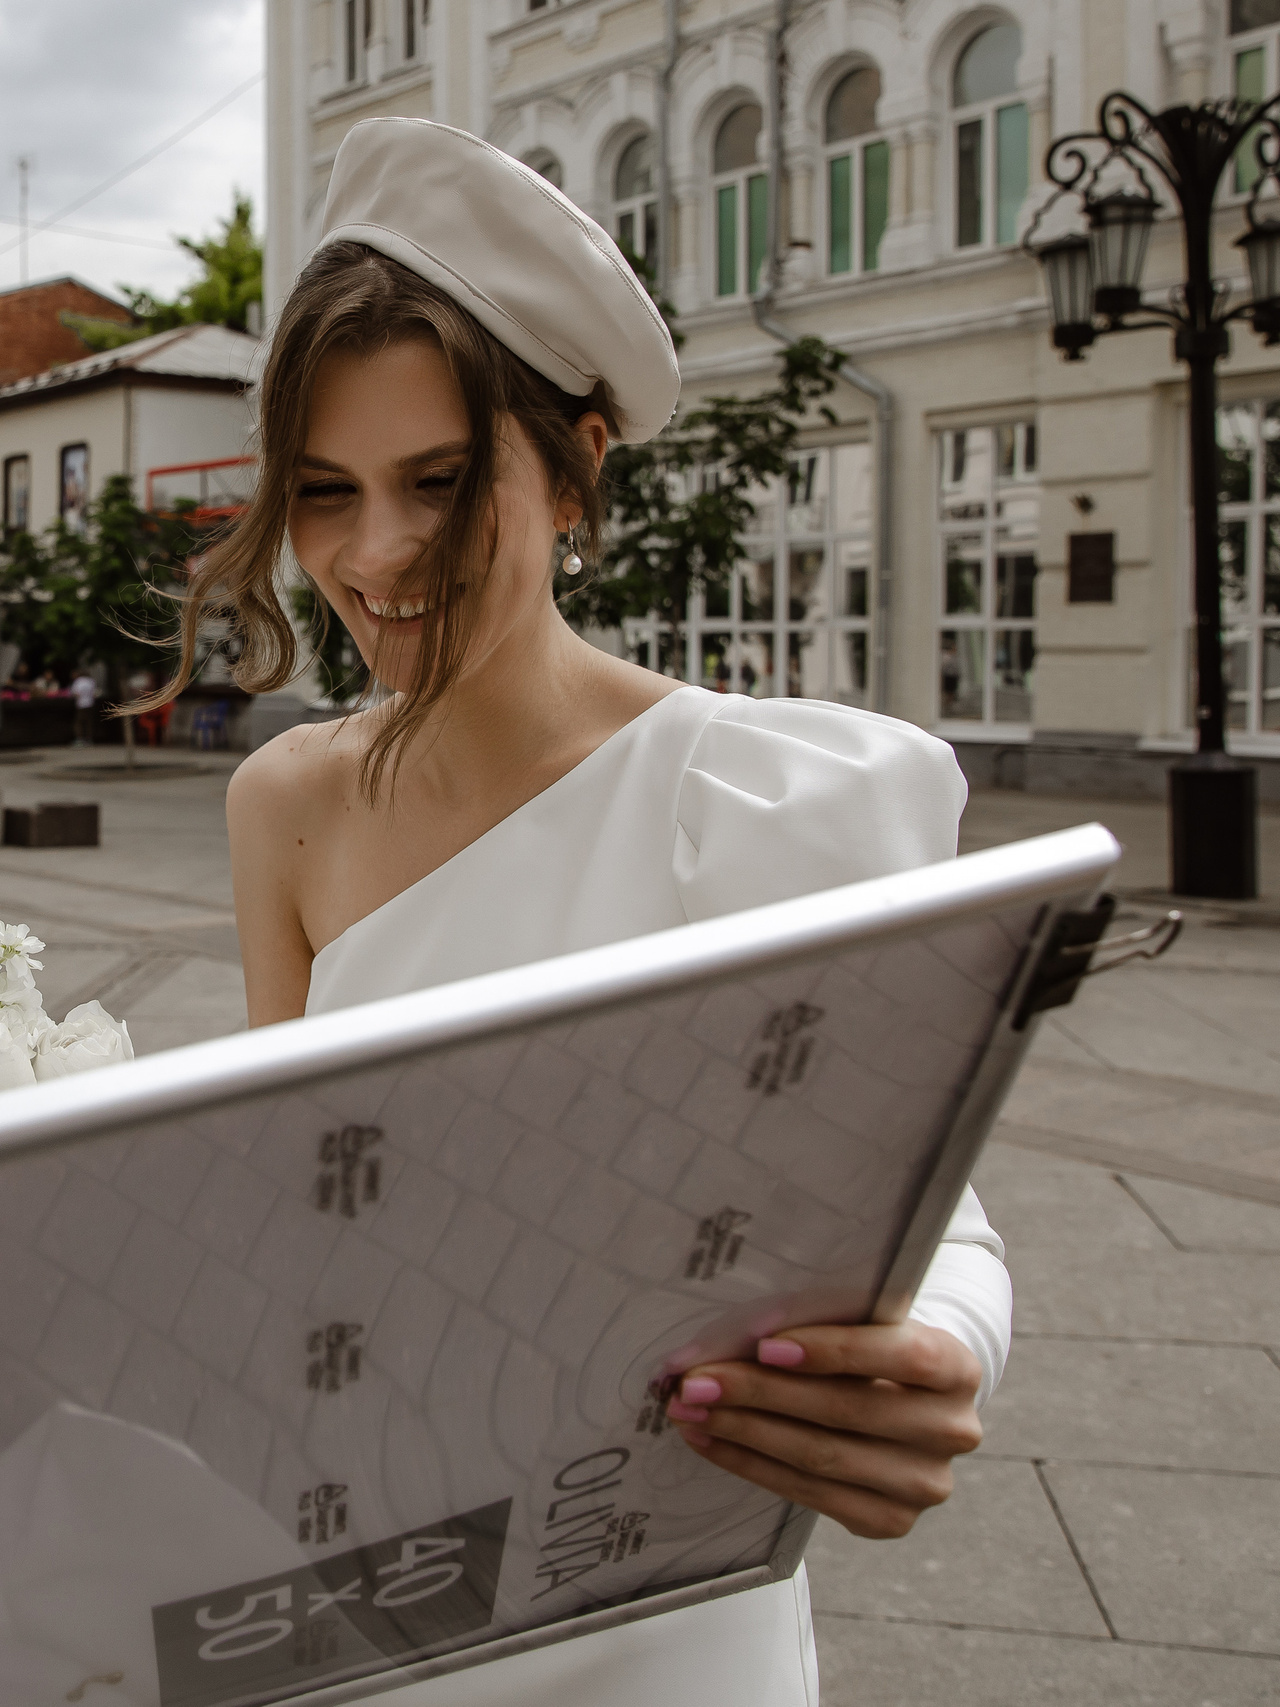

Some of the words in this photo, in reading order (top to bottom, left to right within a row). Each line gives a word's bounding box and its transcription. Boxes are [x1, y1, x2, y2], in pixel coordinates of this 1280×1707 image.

[530, 1447, 630, 1602] OLIVIA
[372, 1536, 466, 1608] 40
[194, 1586, 294, 1661] 50
